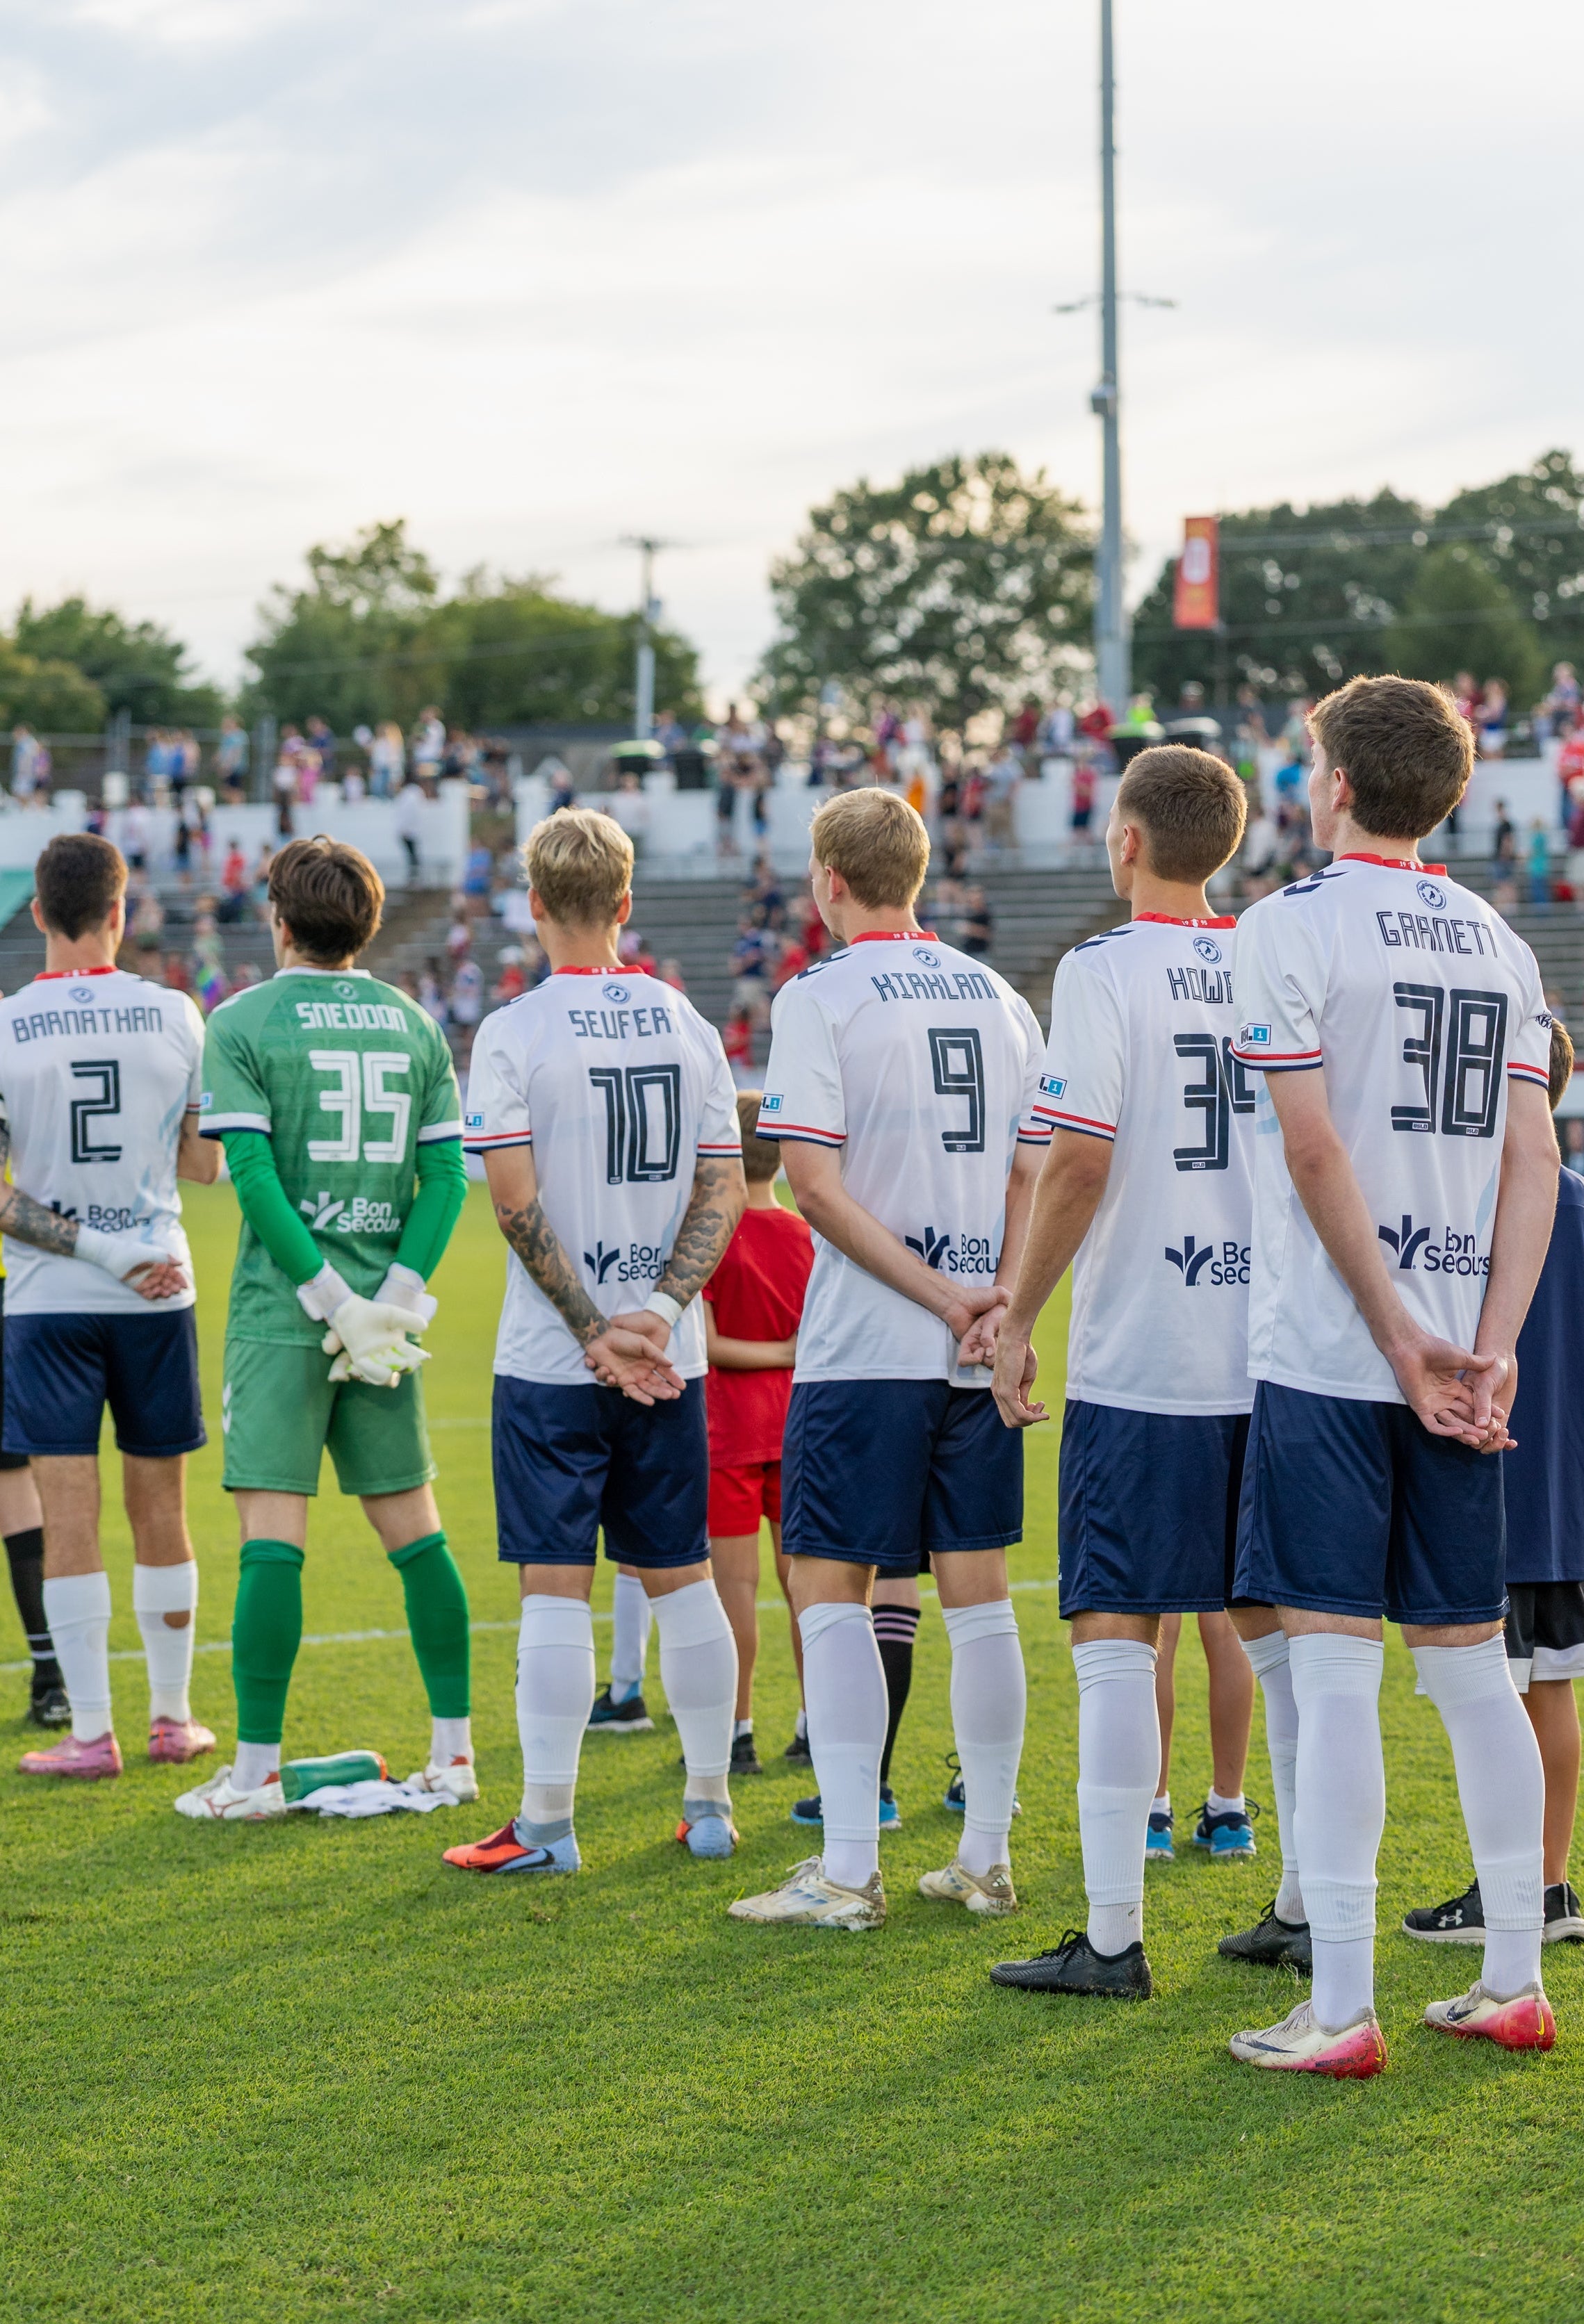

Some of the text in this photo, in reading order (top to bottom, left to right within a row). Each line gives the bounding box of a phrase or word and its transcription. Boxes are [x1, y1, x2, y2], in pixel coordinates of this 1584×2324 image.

[1376, 911, 1498, 958] GARNETT
[12, 1006, 163, 1043] BARNATHAN
[296, 1002, 409, 1033] SNEDDON
[568, 1007, 679, 1039] SEUFER
[1391, 981, 1508, 1139] 38
[927, 1028, 986, 1153] 9
[70, 1060, 122, 1163] 2
[307, 1049, 412, 1164] 35
[589, 1064, 681, 1185] 10
[88, 1204, 131, 1221] Bon
[336, 1211, 401, 1234] Secour
[352, 1197, 392, 1218] Bon
[961, 1233, 989, 1255] Bon
[1223, 1241, 1251, 1265] Bo
[1445, 1226, 1476, 1254] Bon
[947, 1250, 999, 1274] Secou
[1423, 1245, 1489, 1276] Seours
